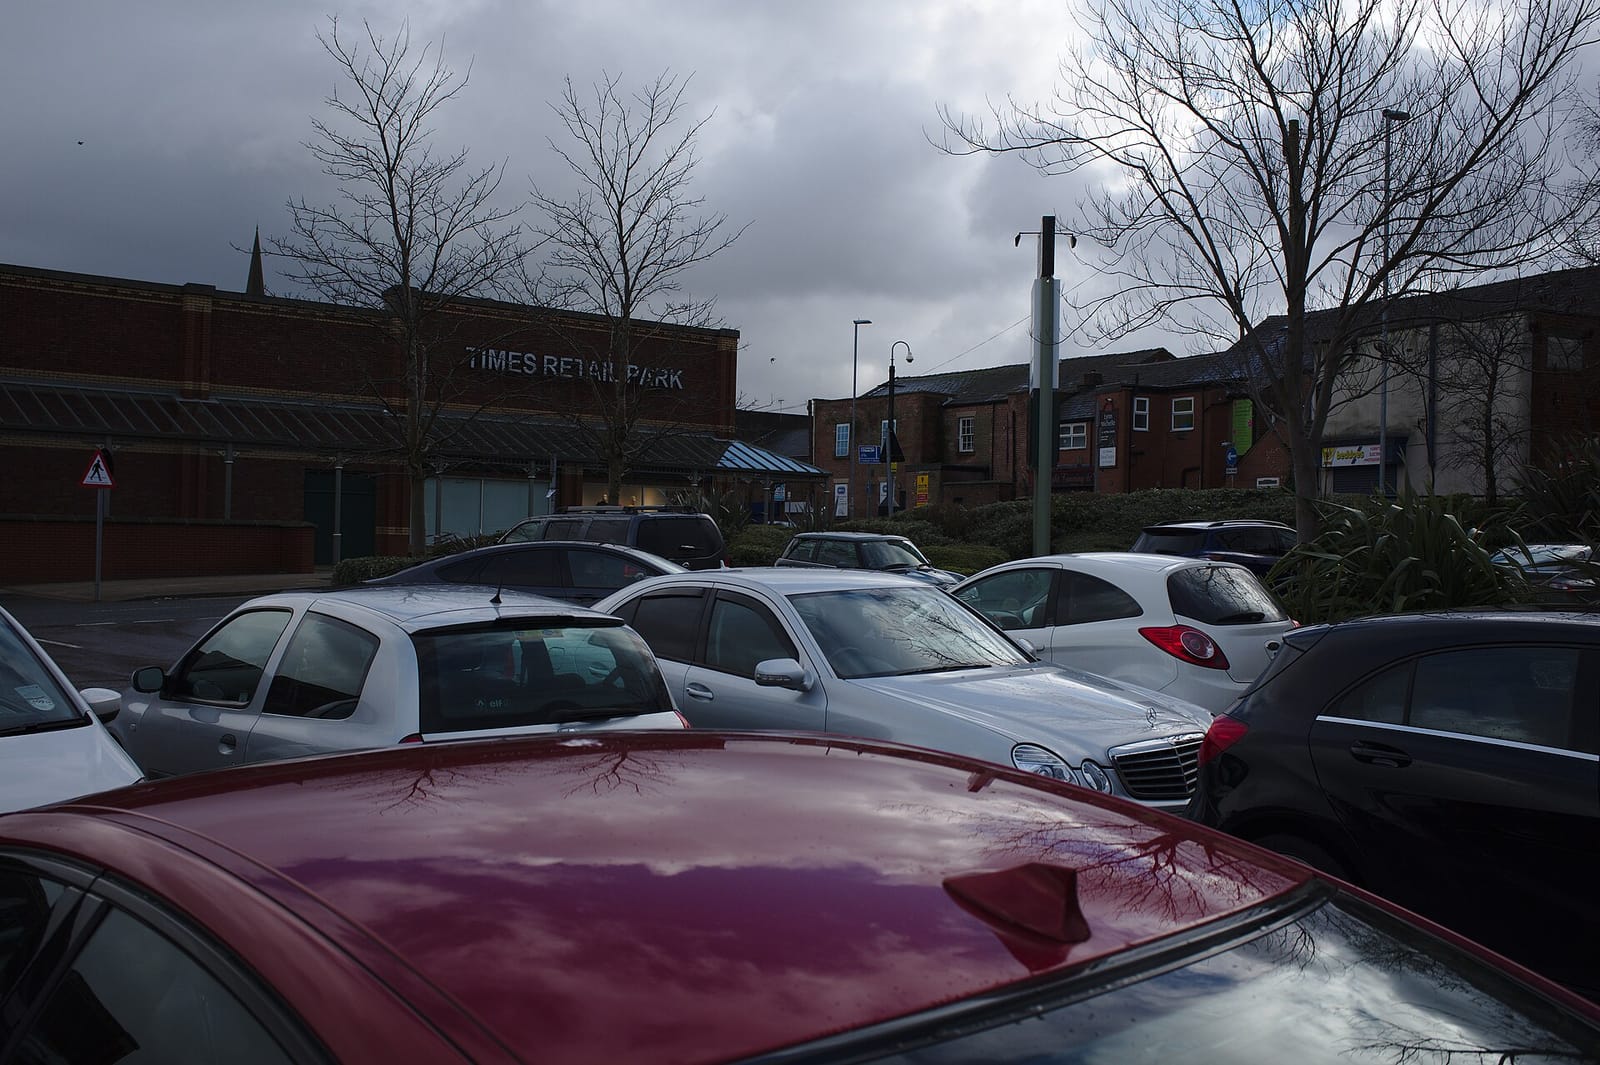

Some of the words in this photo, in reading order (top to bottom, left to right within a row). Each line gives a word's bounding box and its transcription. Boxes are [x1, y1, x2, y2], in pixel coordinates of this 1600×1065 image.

[465, 346, 537, 375] TIMES
[543, 355, 619, 384] RETAIL
[626, 364, 684, 390] PARK
